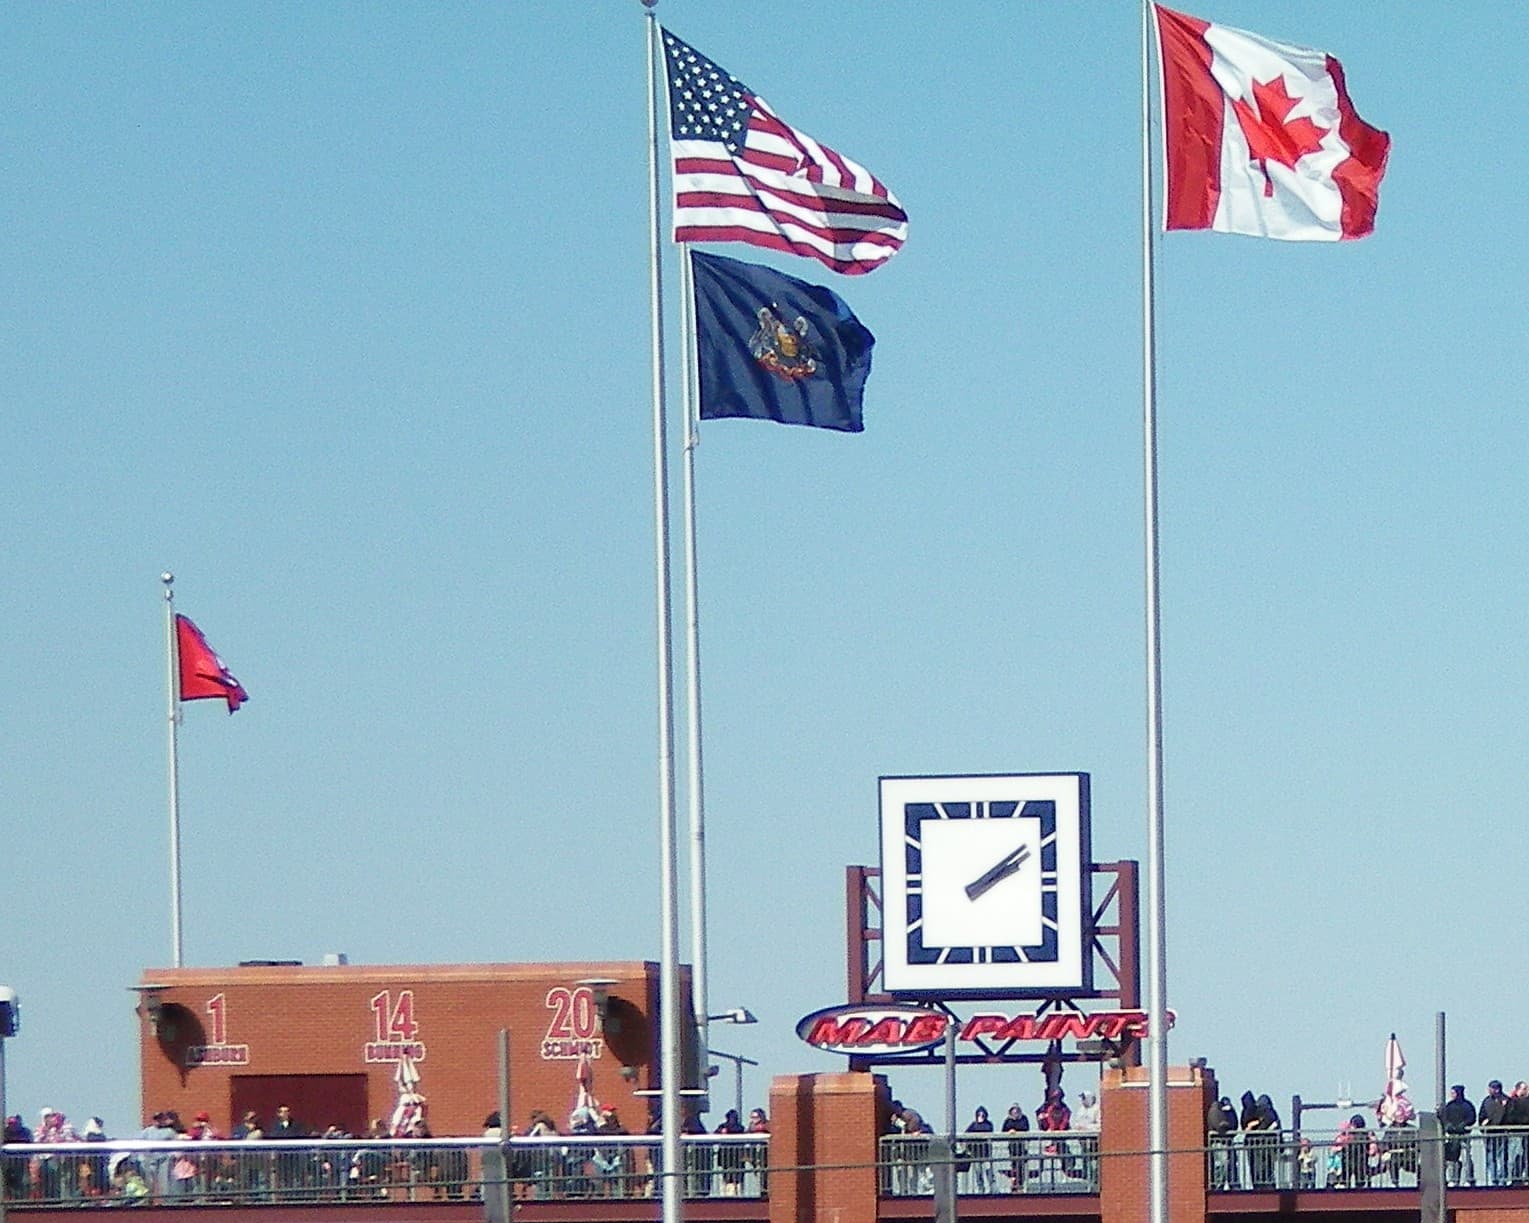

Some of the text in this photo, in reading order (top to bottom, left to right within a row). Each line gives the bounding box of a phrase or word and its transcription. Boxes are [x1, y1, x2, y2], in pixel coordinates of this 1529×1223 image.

[206, 992, 226, 1045] 1
[371, 990, 419, 1042] 14
[546, 987, 597, 1039] 20
[805, 1010, 1177, 1048] MAB PAINTS
